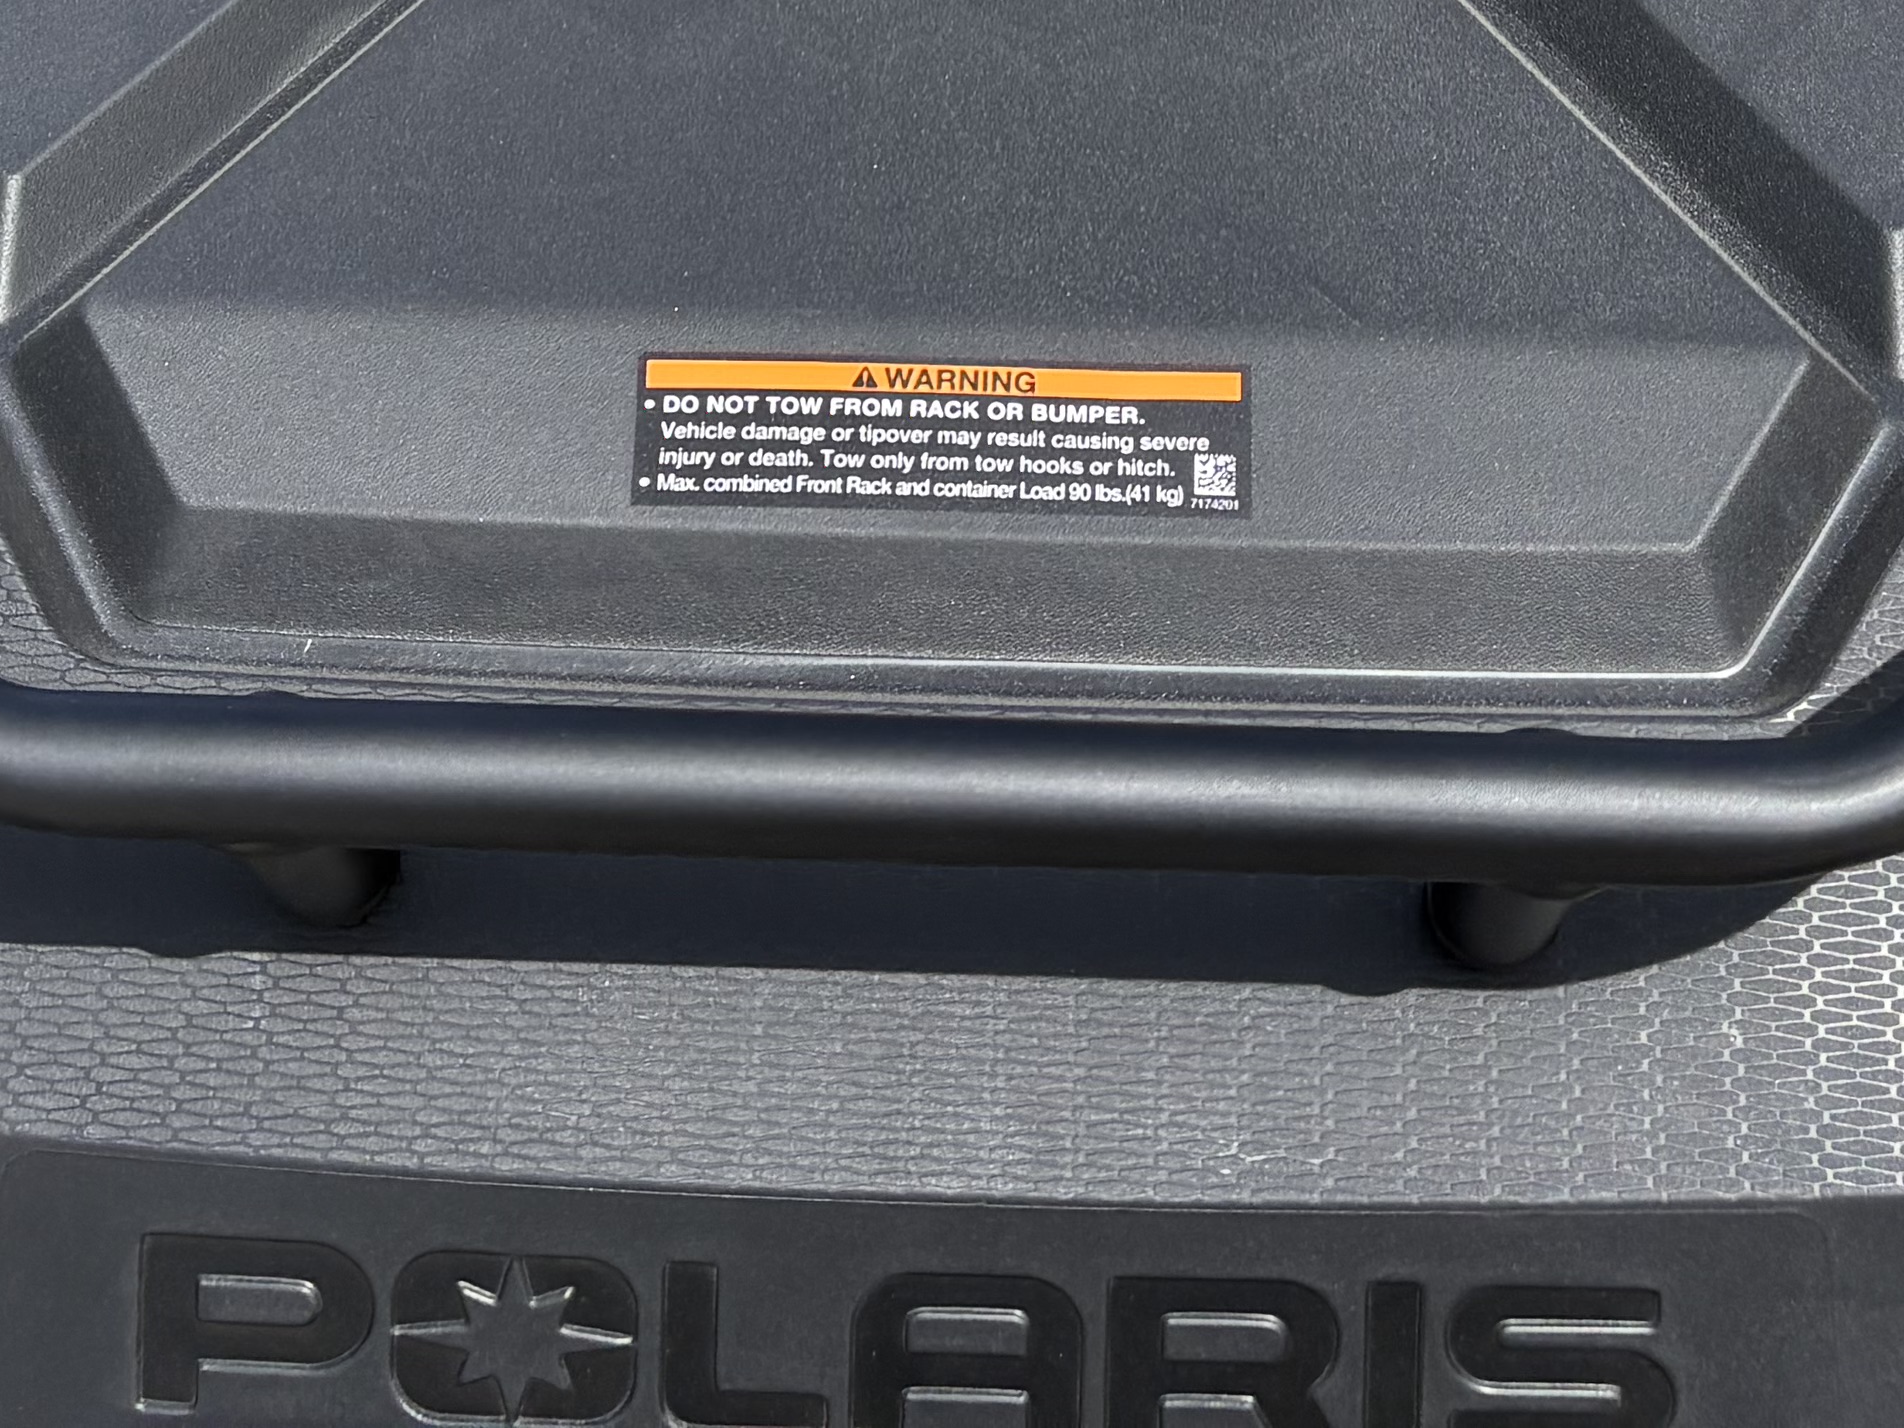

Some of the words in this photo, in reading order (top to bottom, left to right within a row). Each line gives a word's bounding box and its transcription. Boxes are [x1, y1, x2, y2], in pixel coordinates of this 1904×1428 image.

[885, 366, 1036, 394] WARNING
[663, 395, 699, 414] DO
[706, 395, 759, 414] NOT
[766, 396, 823, 416] TOW
[829, 397, 902, 418] FROM
[910, 399, 979, 420] RACK
[987, 402, 1024, 420] OR
[1031, 404, 1146, 425] BUMPER.
[661, 421, 735, 440] Vehicle
[741, 422, 826, 445] damage
[831, 427, 855, 442] or
[859, 424, 933, 446] tipover
[937, 430, 981, 449] may
[987, 429, 1046, 447] result
[1051, 432, 1134, 453] causing
[1139, 436, 1210, 451] severe
[658, 447, 716, 469] injury
[720, 451, 744, 467] or
[748, 448, 814, 467] death.
[820, 449, 866, 468] Tow
[870, 451, 915, 473] only
[920, 452, 969, 471] from
[975, 456, 1014, 473] tow
[1019, 456, 1084, 475] hooks
[1089, 462, 1113, 476] or
[1118, 458, 1176, 477] hitch.
[657, 474, 699, 492] Max.
[703, 474, 792, 493] combined
[797, 475, 842, 494] Front
[847, 476, 892, 496] Rack
[895, 477, 930, 497] and
[934, 480, 1016, 500] container
[1020, 482, 1066, 501] Load
[1069, 483, 1092, 502] 90
[1156, 485, 1184, 507] kg)
[1190, 497, 1239, 511] 7174201
[134, 1232, 1677, 1428] POLARIS
